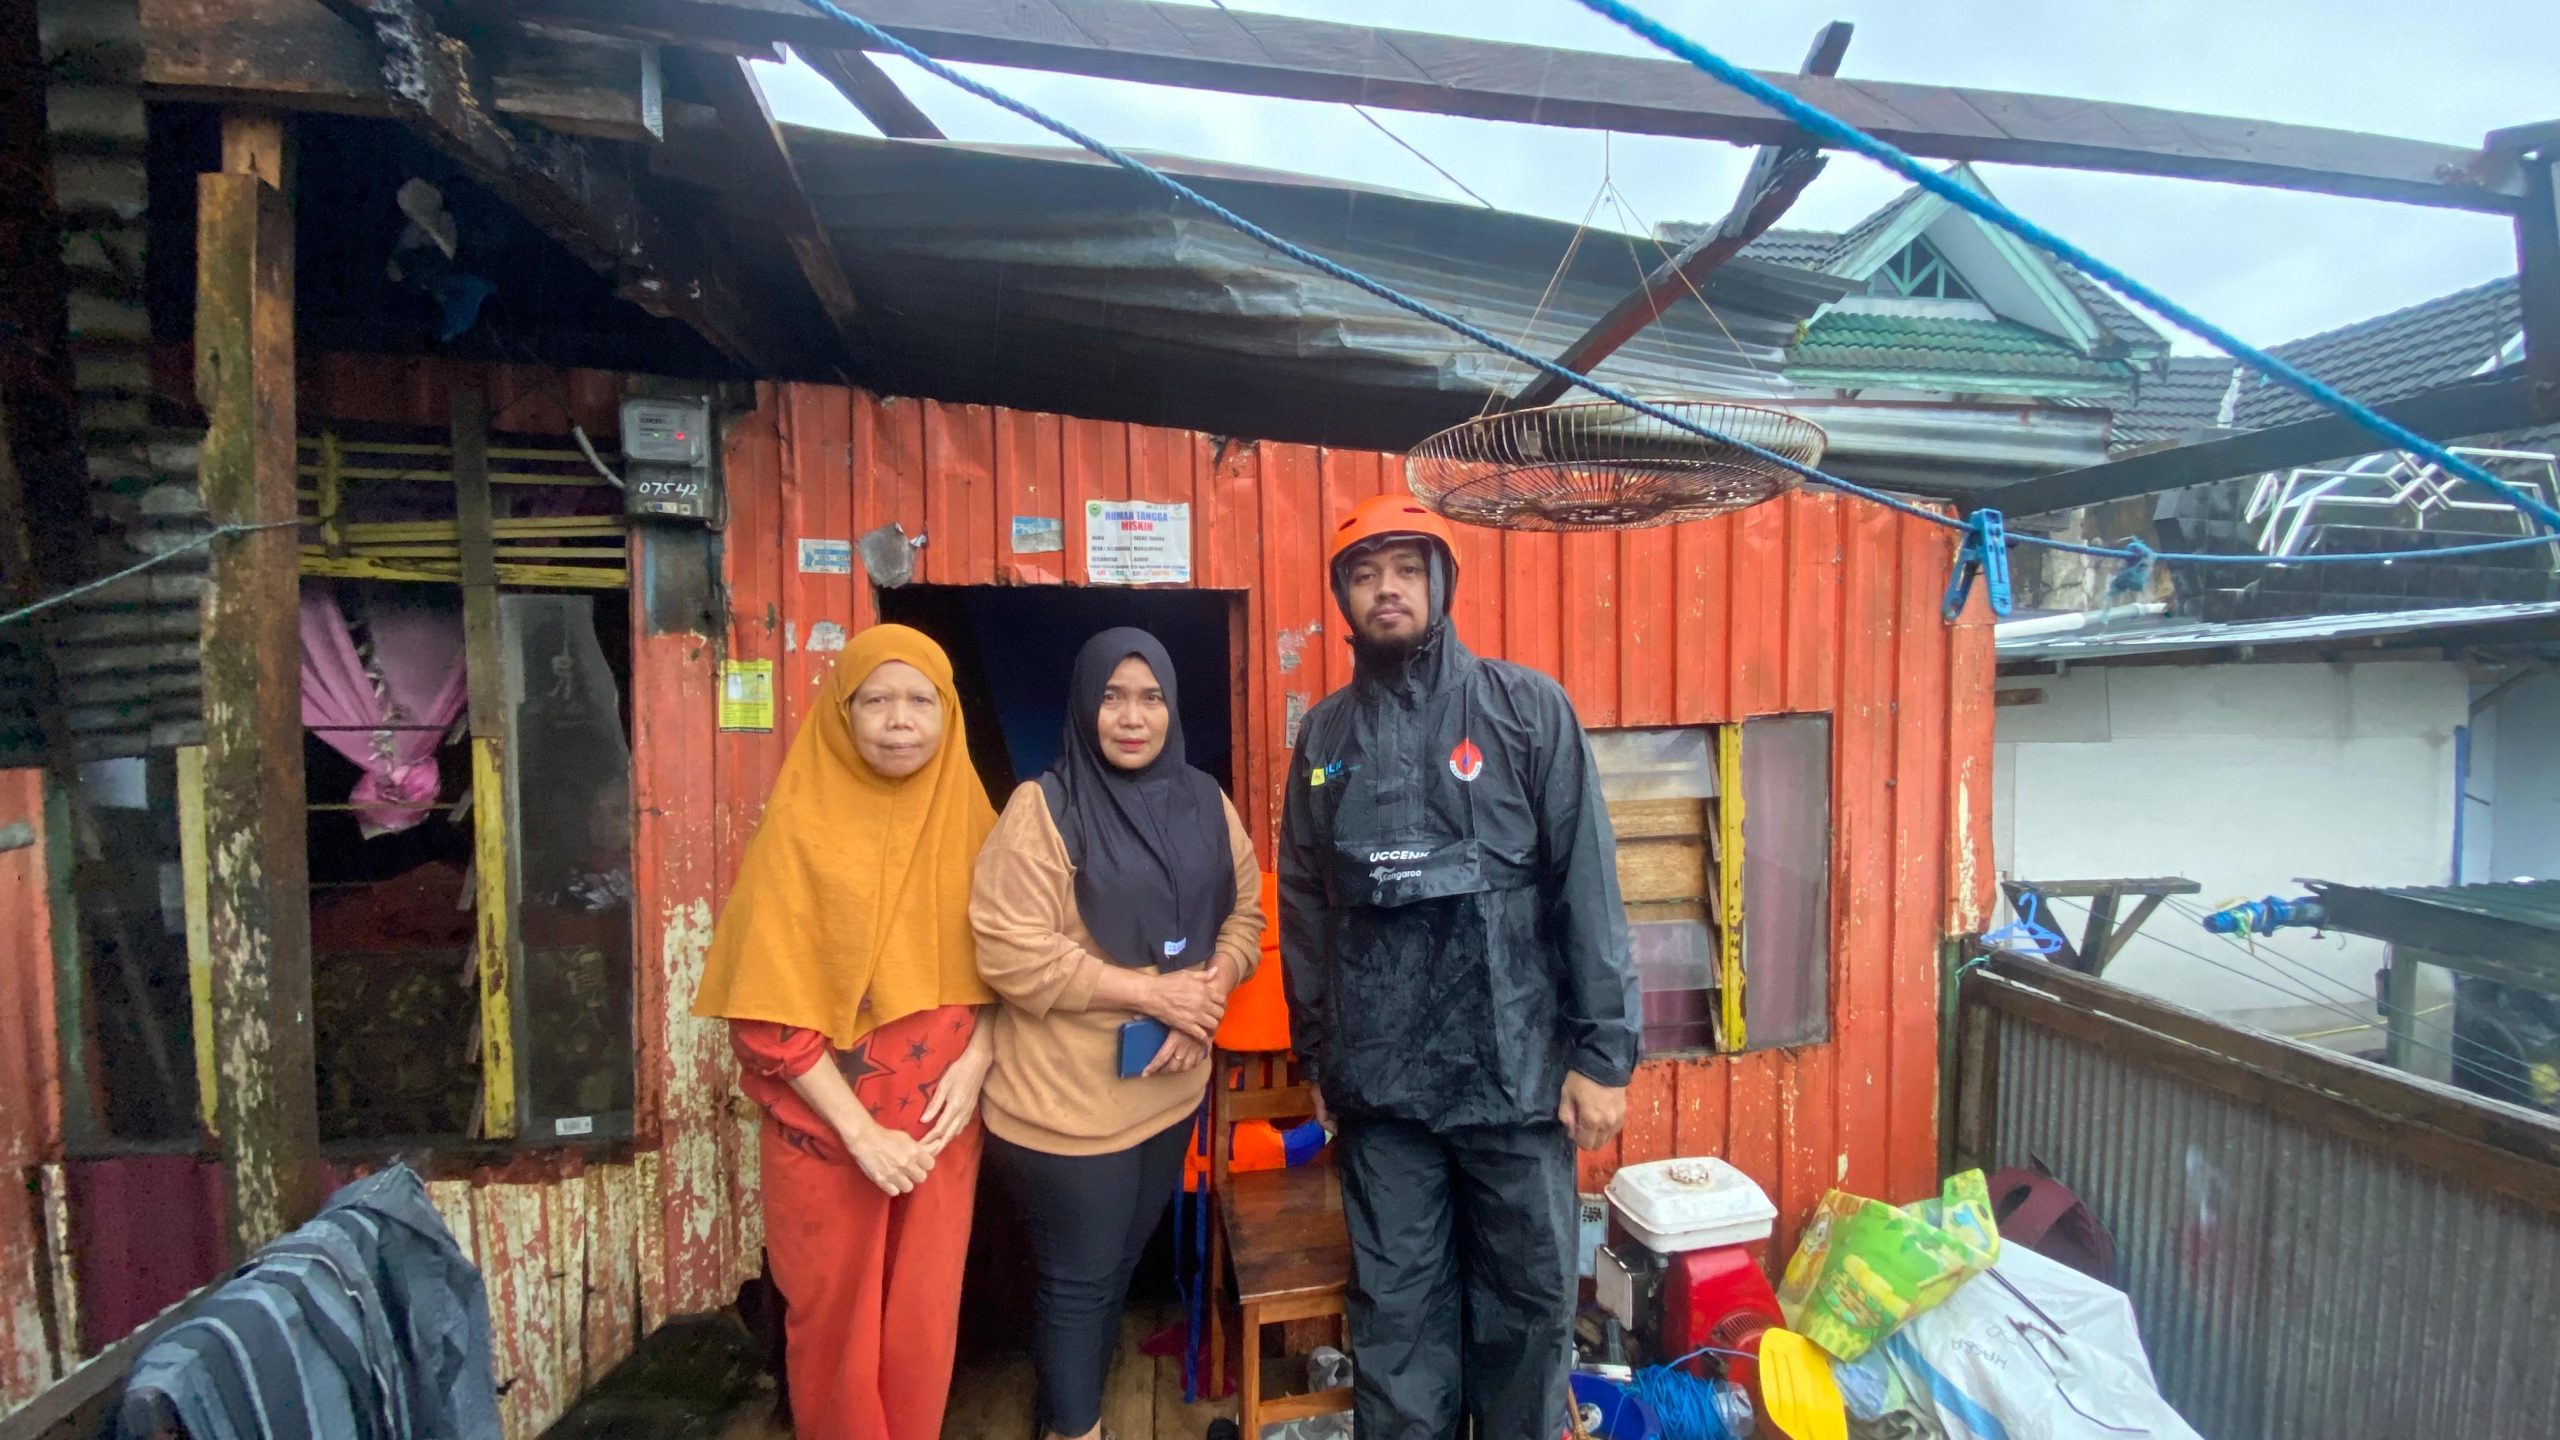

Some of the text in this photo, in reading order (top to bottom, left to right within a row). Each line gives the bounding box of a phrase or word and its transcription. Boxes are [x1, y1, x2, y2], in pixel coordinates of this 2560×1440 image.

[639, 481, 698, 498] 07542
[1137, 512, 1168, 521] TANGGA
[1121, 520, 1153, 531] MISKIN
